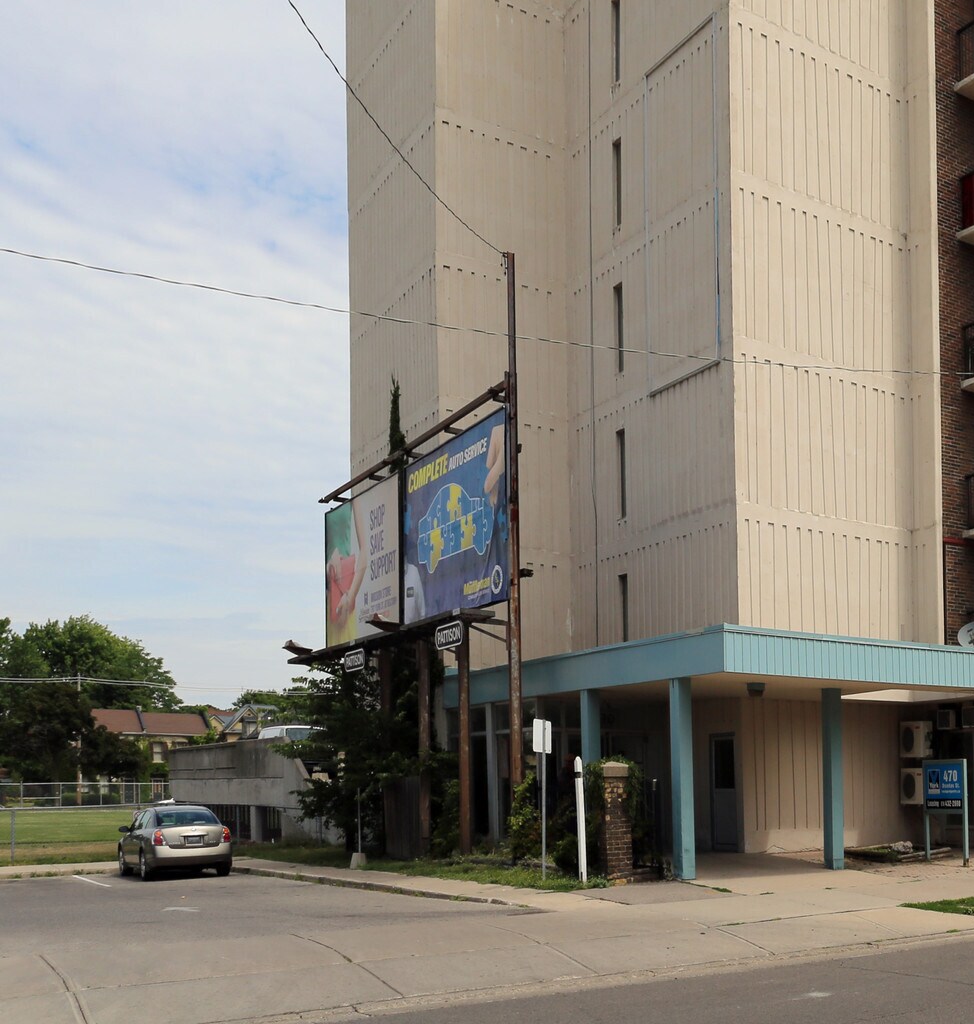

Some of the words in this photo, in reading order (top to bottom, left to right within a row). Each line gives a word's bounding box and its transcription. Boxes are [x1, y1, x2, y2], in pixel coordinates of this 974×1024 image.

[408, 453, 448, 494] COMPLETE
[448, 451, 464, 472] AUTO
[463, 437, 488, 464] SERVICE
[370, 503, 385, 531] SHOP
[370, 529, 384, 556] SAVE
[370, 549, 397, 581] SUPPORT
[437, 626, 461, 645] PATTISON
[345, 653, 364, 667] PATTISON
[943, 770, 958, 782] 470
